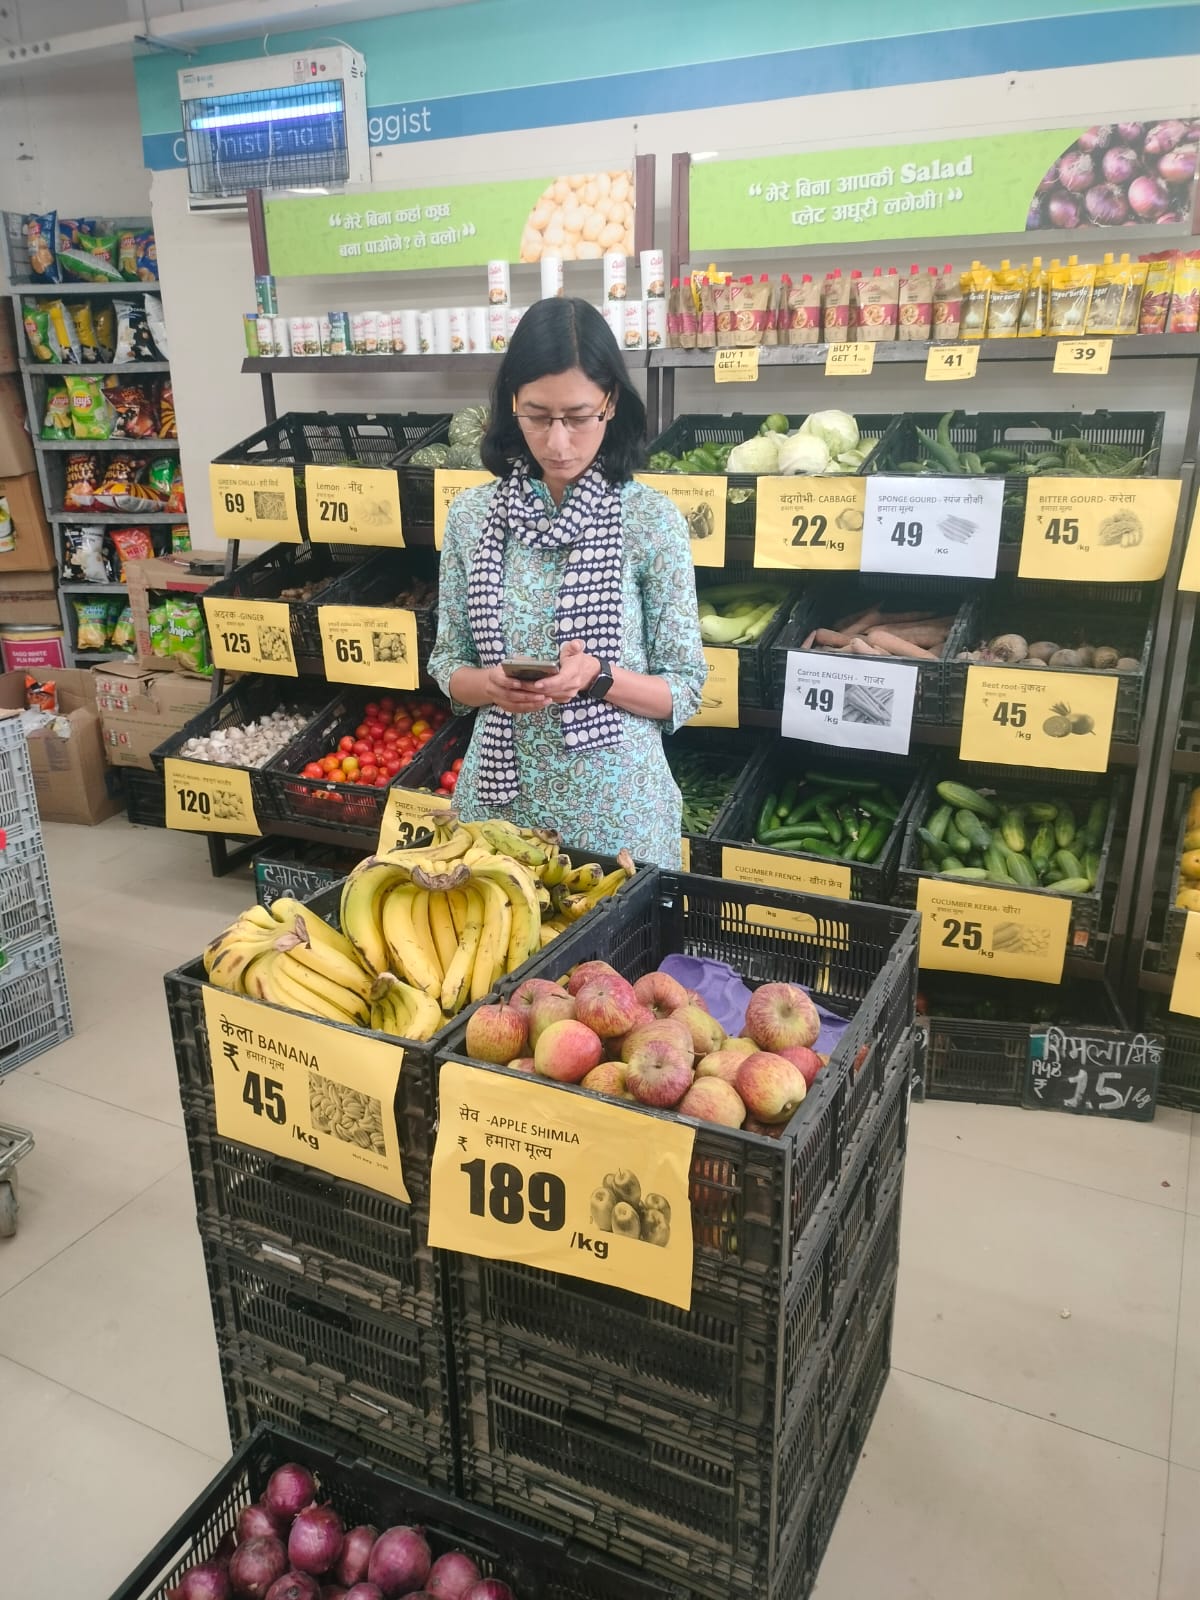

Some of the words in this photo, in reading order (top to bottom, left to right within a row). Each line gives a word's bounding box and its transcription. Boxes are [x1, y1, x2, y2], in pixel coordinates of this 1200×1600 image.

[796, 177, 831, 199] बिना
[836, 167, 895, 193] आपकी
[900, 155, 973, 185] Salad
[366, 209, 392, 228] बिना
[791, 204, 826, 226] प्लेट
[832, 196, 877, 223] अधूरी
[339, 243, 361, 257] बना
[414, 231, 426, 248] ले
[720, 350, 738, 359] BUY
[831, 354, 848, 363] GET
[833, 344, 852, 353] BUY
[718, 360, 736, 369] GET
[316, 481, 340, 491] Lemon
[225, 492, 245, 513] 69
[818, 494, 857, 503] CABBAGE
[878, 494, 909, 503] SPONGE
[909, 495, 937, 504] GOURD
[1039, 494, 1068, 503] BITTER
[1108, 492, 1137, 504] करेला
[319, 501, 348, 523] 270
[791, 514, 827, 546] 22
[890, 521, 923, 547] 49
[1045, 518, 1080, 545] 45
[221, 632, 251, 654] 125
[336, 638, 363, 663] 65
[797, 668, 821, 678] Carrot
[821, 671, 853, 681] ENGLISH
[804, 688, 834, 712] 49
[992, 701, 1027, 728] 45
[1015, 730, 1032, 741] /kg
[177, 788, 210, 815] 120
[735, 865, 773, 877] CUCUMBER
[774, 871, 801, 882] FRENCH
[931, 897, 974, 910] CUCUMBER
[942, 918, 982, 951] 25
[219, 1013, 254, 1045] केला
[258, 1034, 320, 1071] BANANA
[246, 1049, 267, 1066] हमारा
[269, 1056, 285, 1072] मूल्य
[222, 1040, 240, 1073] ₹
[242, 1070, 287, 1126] 45
[291, 1124, 320, 1150] /kg
[459, 1103, 480, 1123] सेव
[530, 1124, 580, 1146] SHIMLA
[457, 1135, 468, 1152] ₹
[484, 1132, 521, 1153] हमारा
[524, 1140, 553, 1161] मूल्य
[460, 1157, 567, 1233] 189
[570, 1231, 609, 1260] /kg
